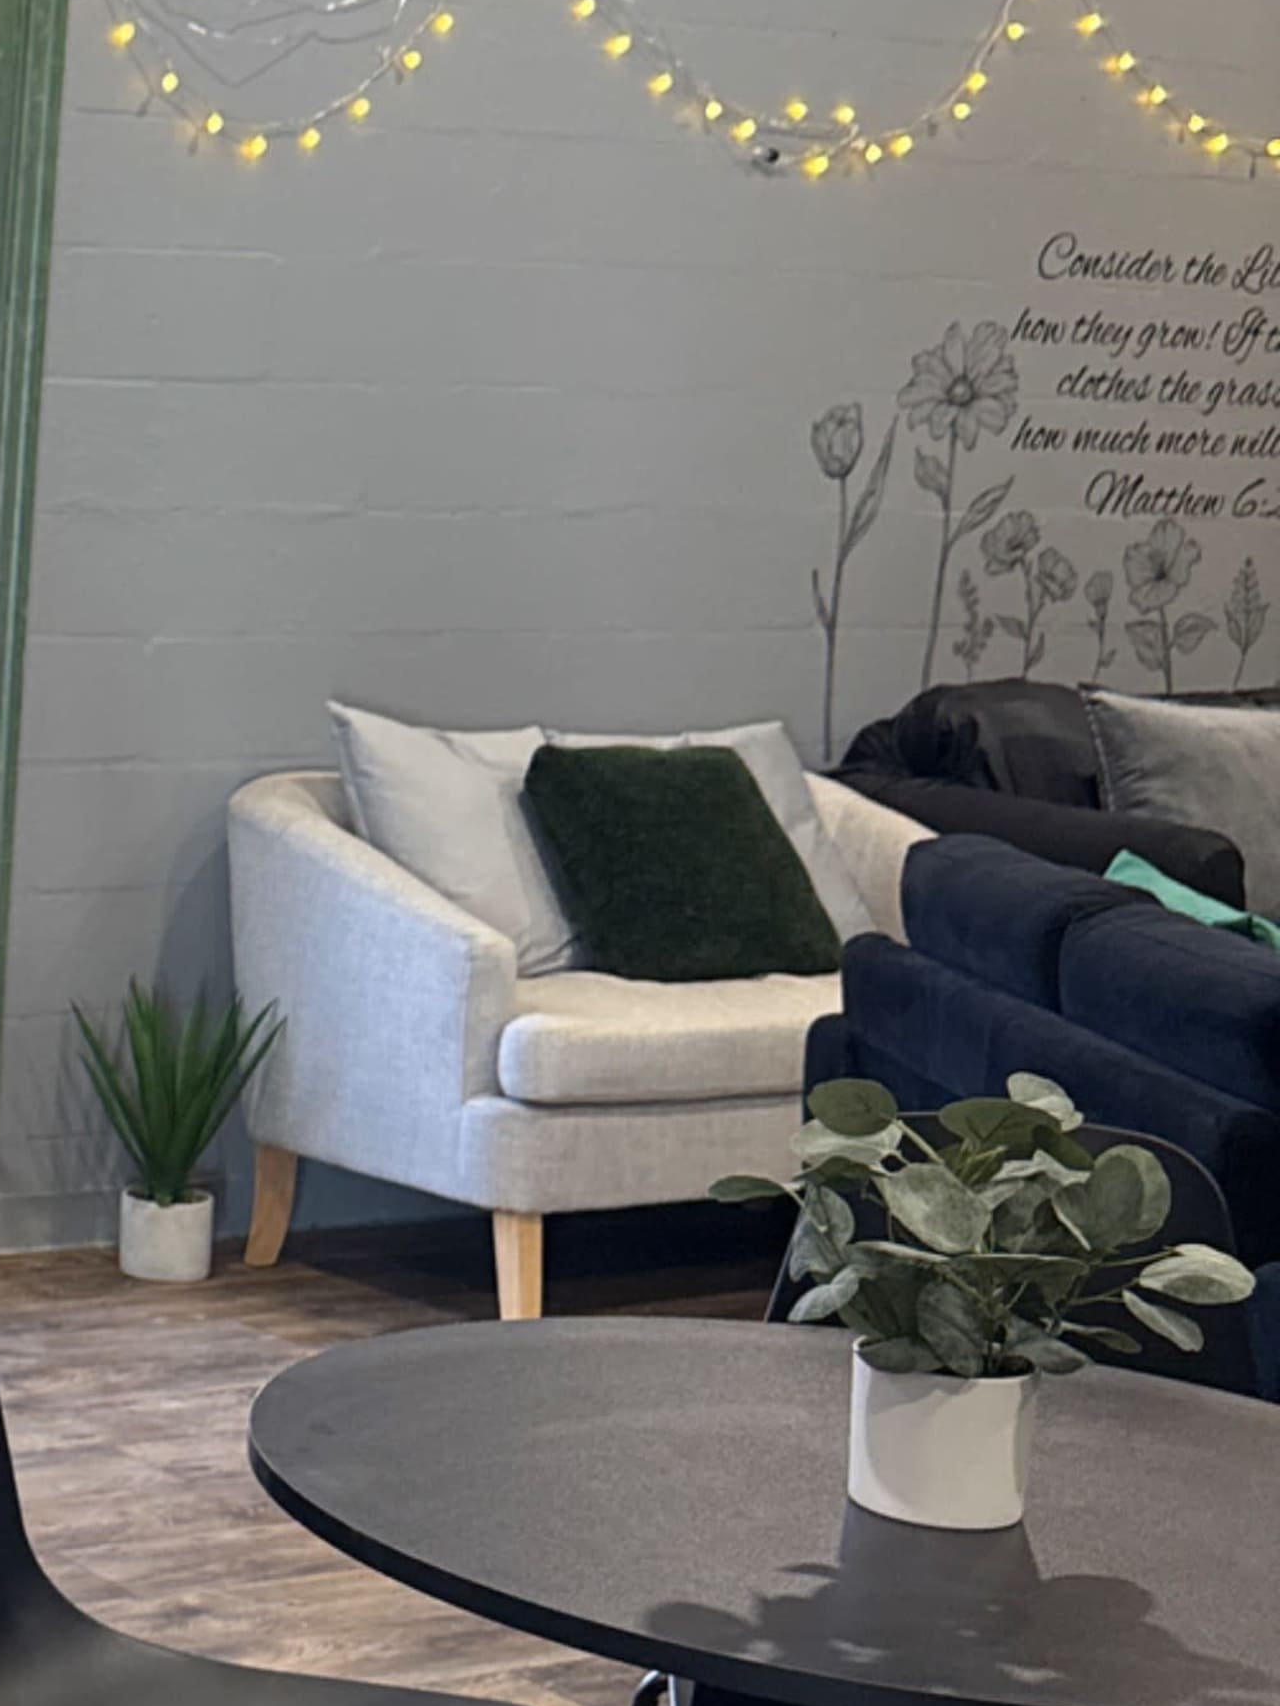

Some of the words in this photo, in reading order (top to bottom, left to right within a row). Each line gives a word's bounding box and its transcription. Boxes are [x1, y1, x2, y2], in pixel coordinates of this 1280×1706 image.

[1038, 231, 1177, 283] Consider
[1183, 252, 1228, 286] the
[1010, 306, 1066, 345] how
[1071, 310, 1133, 358] they
[1133, 319, 1222, 359] grow!
[1056, 363, 1153, 403] clothes
[1158, 369, 1202, 405] the
[1010, 415, 1067, 452] how
[1072, 419, 1151, 454] much
[1155, 428, 1226, 457] more
[1084, 469, 1225, 518] Matthew
